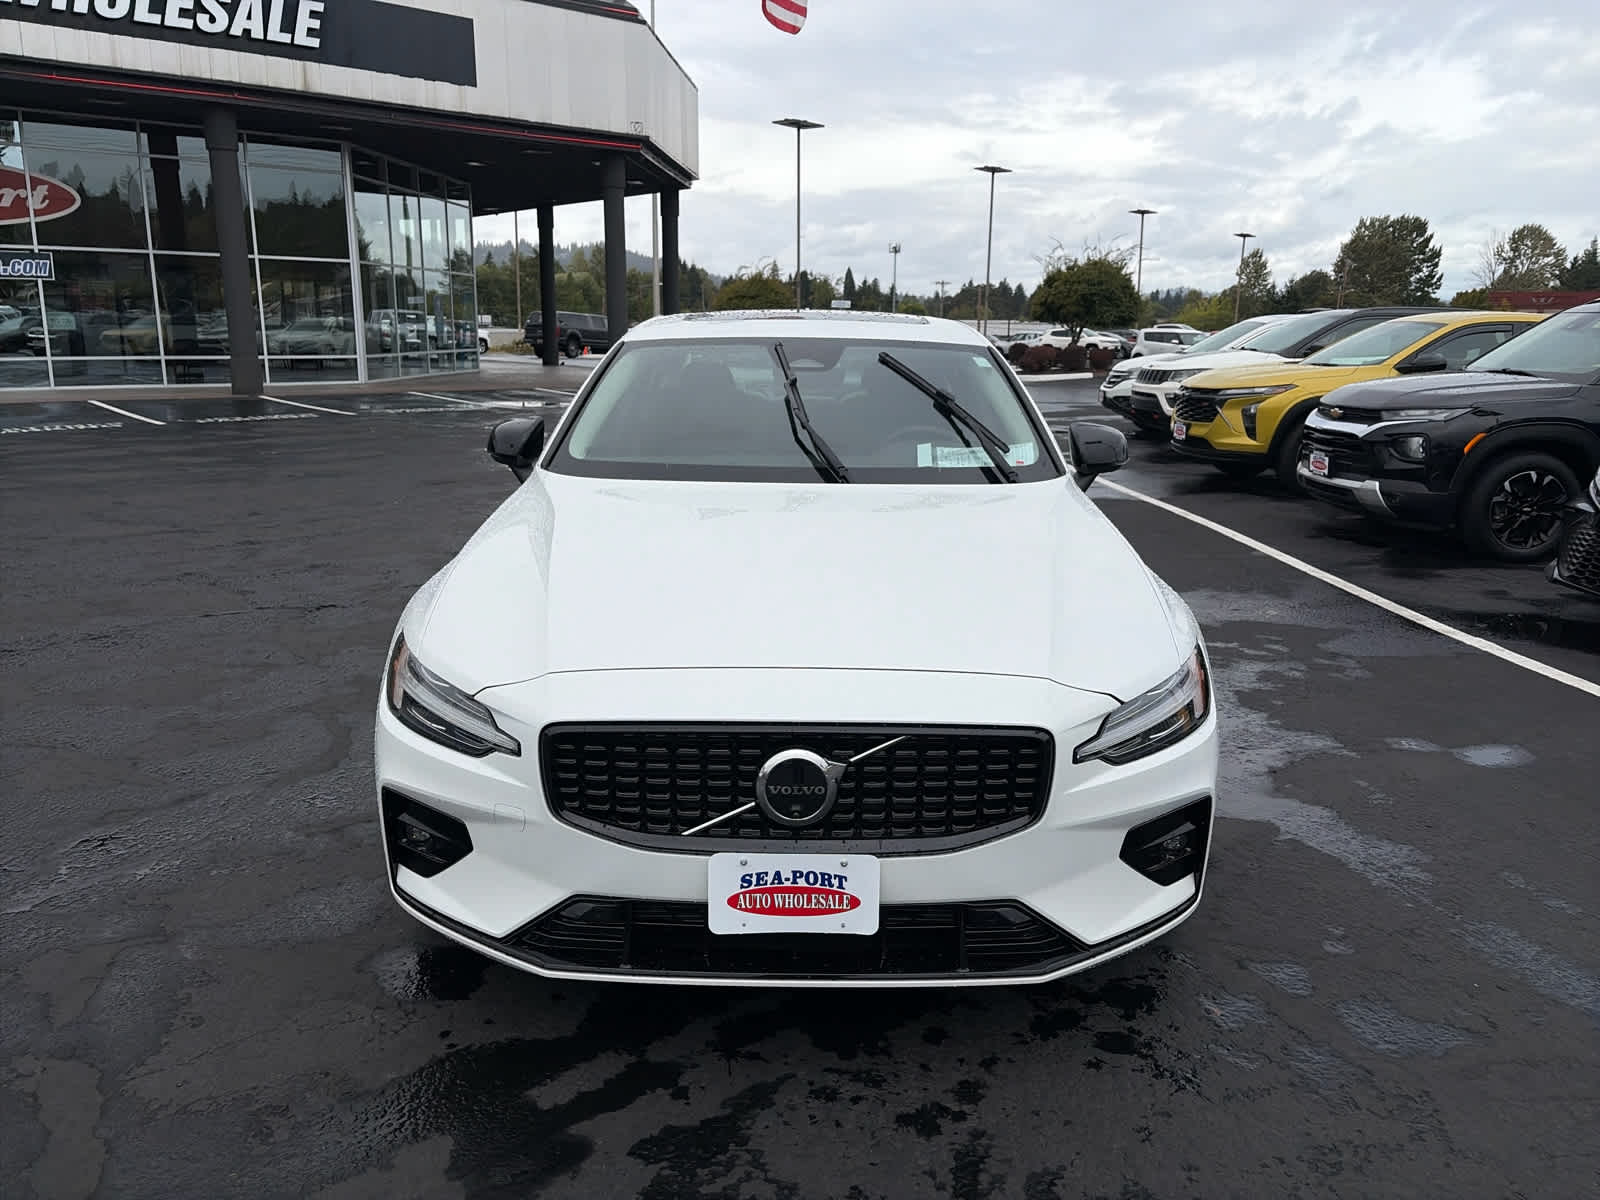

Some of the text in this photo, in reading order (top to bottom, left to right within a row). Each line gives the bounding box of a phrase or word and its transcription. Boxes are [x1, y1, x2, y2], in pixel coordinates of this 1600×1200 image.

[0, 0, 325, 49] LESALE
[0, 259, 50, 277] .COM
[768, 785, 825, 795] VOLVO
[740, 870, 848, 890] SEA-PORT
[737, 893, 851, 910] AUTO WHOLESALE
